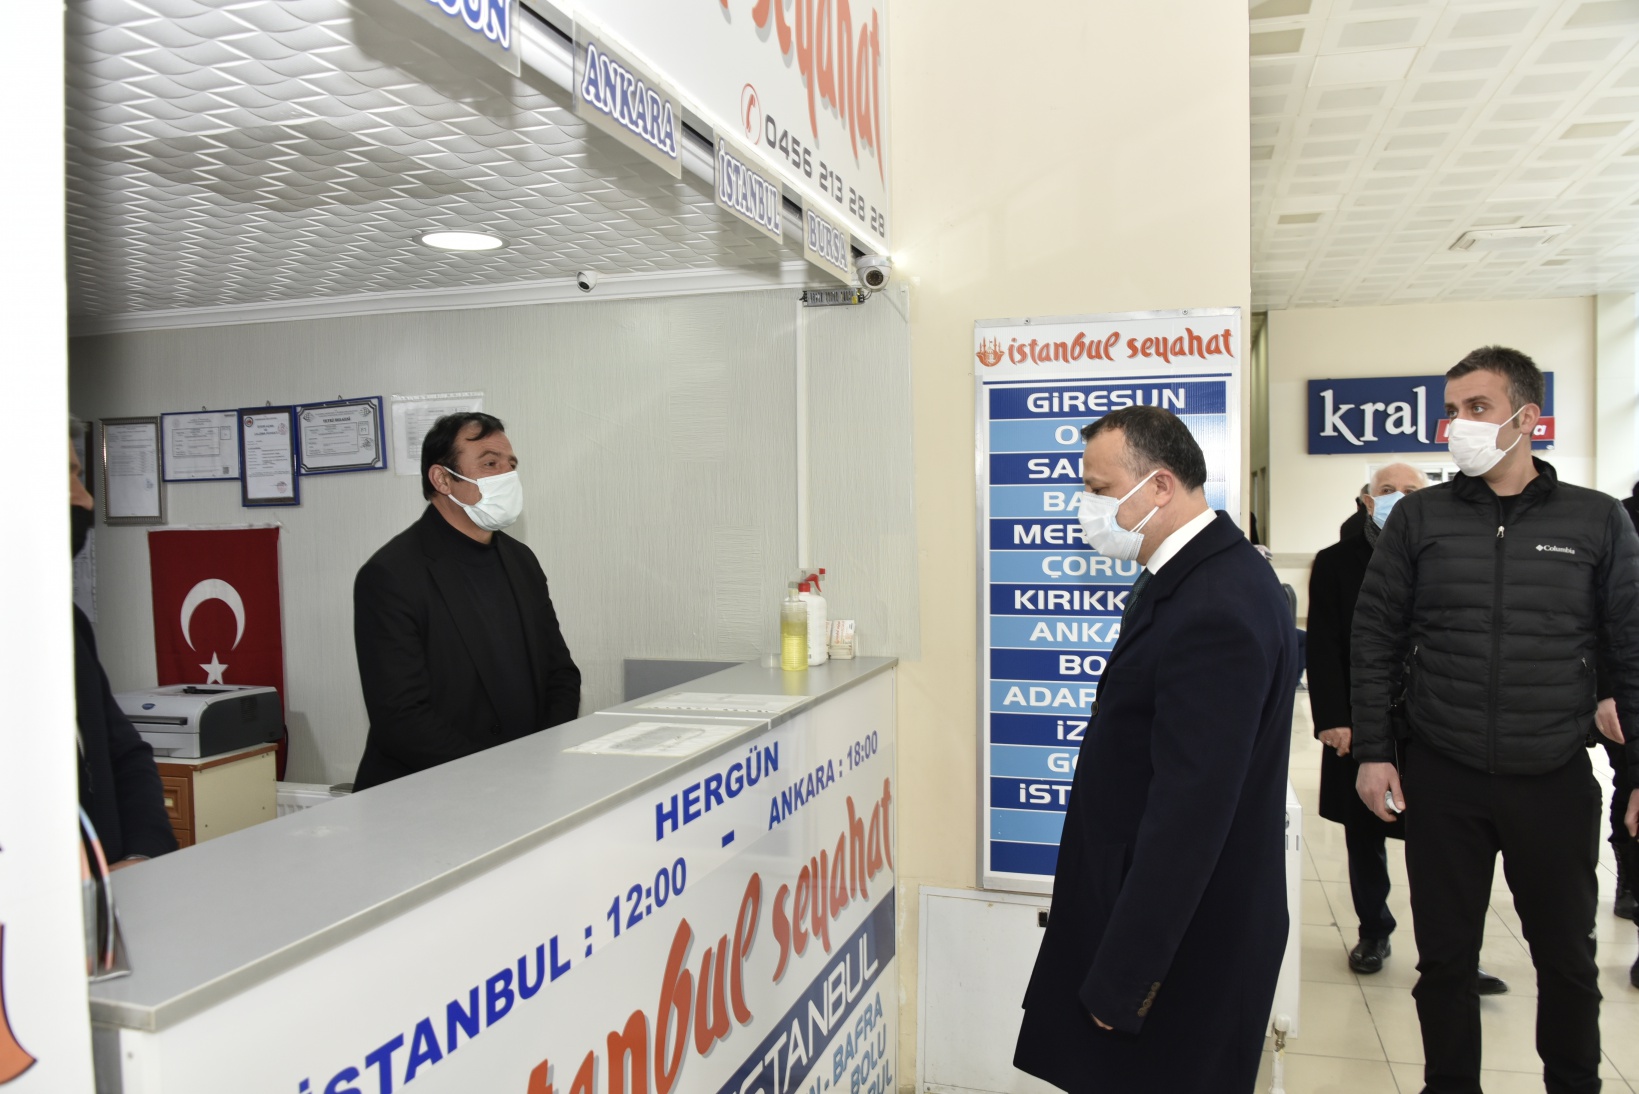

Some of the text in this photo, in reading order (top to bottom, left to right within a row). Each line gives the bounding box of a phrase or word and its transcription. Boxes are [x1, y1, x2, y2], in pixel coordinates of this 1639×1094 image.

[581, 42, 678, 160] ANKARA
[765, 114, 885, 238] 0456 213 28 28
[806, 208, 849, 274] BURSA
[1007, 327, 1235, 366] istanbul seyahat
[1319, 385, 1430, 446] kral
[1028, 458, 1083, 479] SA
[1042, 555, 1146, 578] ÇORU
[1544, 545, 1575, 554] Columbia
[654, 741, 779, 842] HERGÜN
[299, 935, 571, 1094] TANBUL
[607, 857, 687, 939] 12:00
[768, 759, 835, 831] ANKARA
[847, 730, 878, 772] 18:00
[772, 777, 892, 982] seyahat
[833, 991, 882, 1087] BAFRA
